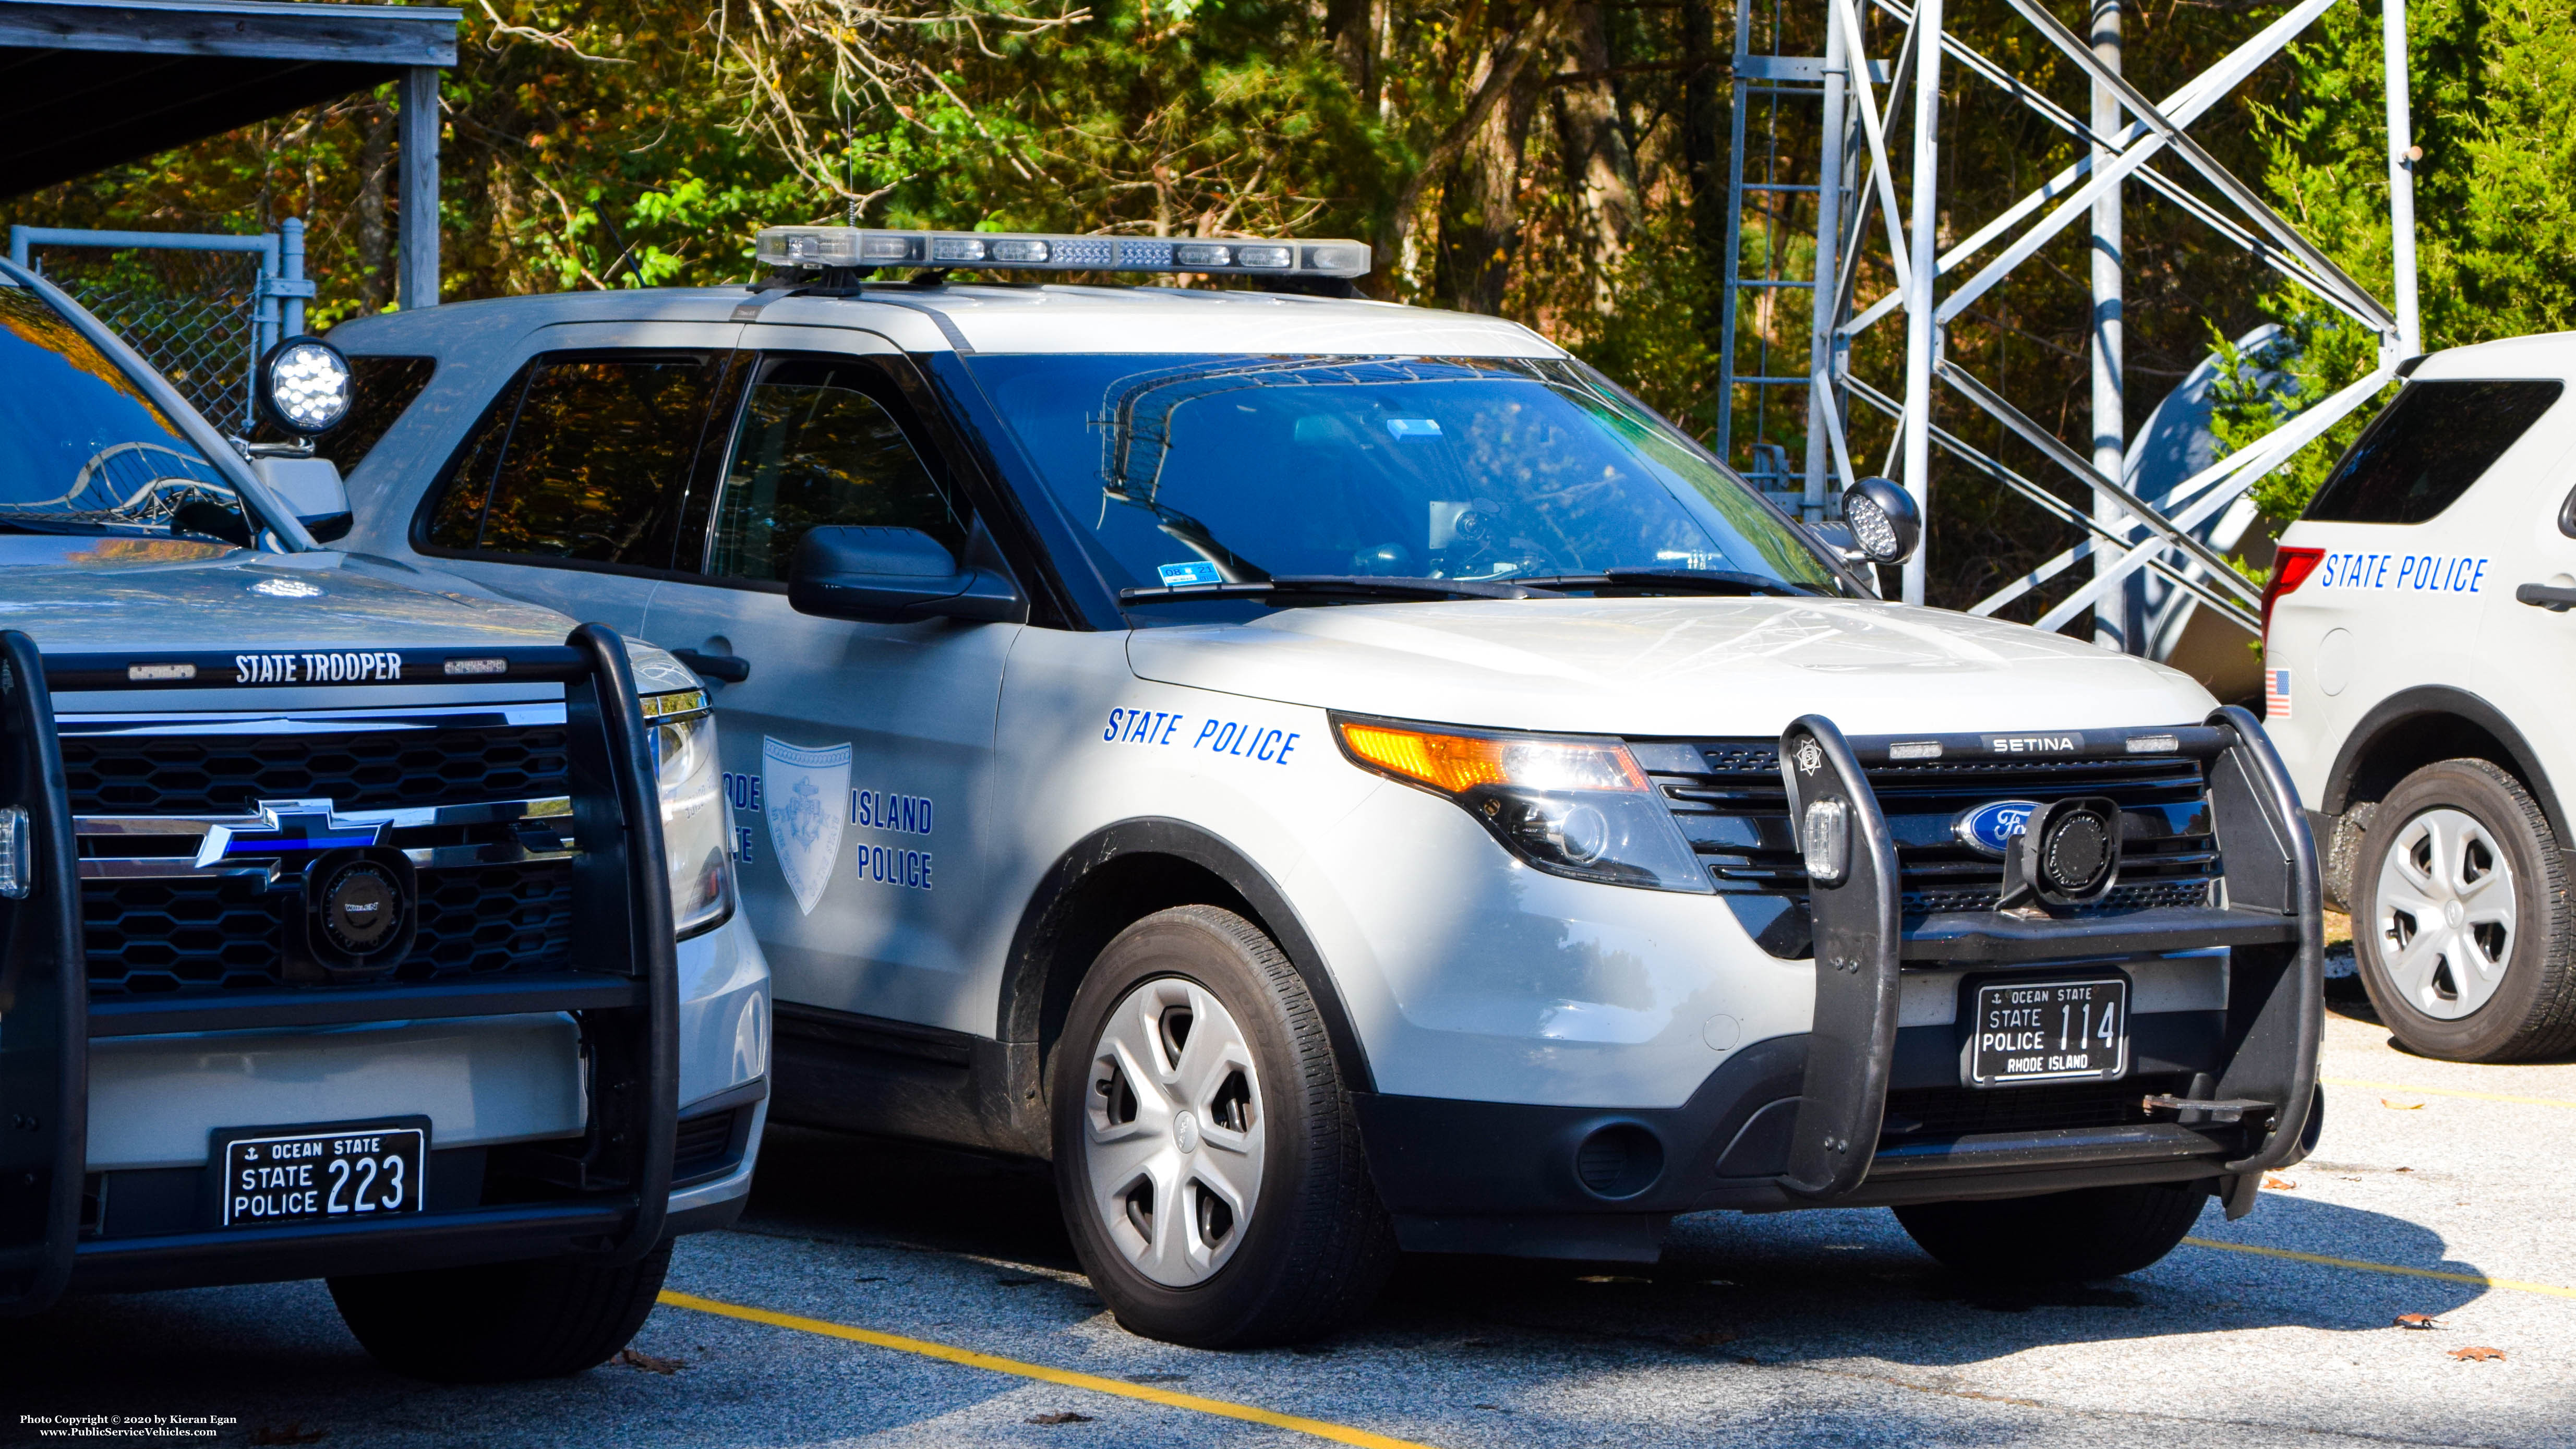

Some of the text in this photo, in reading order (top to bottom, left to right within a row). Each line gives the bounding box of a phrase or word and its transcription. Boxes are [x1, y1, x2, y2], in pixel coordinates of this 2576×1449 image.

[2322, 554, 2488, 592] STATE POLICE
[236, 653, 401, 683] STATE TROOPER
[1103, 708, 1301, 765] STATE POLICE
[1994, 738, 2074, 752] SETINA
[722, 772, 760, 812] ODE
[851, 788, 933, 835] ISLAND
[1994, 810, 2031, 841] Fo
[857, 843, 933, 890] POLICE
[2012, 987, 2092, 1004] OCEAN STATE
[1990, 1009, 2042, 1029] STATE
[2061, 1002, 2114, 1050] 114
[1983, 1031, 2044, 1052] POLICE
[2007, 1054, 2088, 1072] RHODE ISLAND
[272, 1138, 380, 1159] OCEAN STATE
[242, 1165, 313, 1190] STATE
[327, 1155, 404, 1213] 223
[235, 1191, 318, 1217] POLICE
